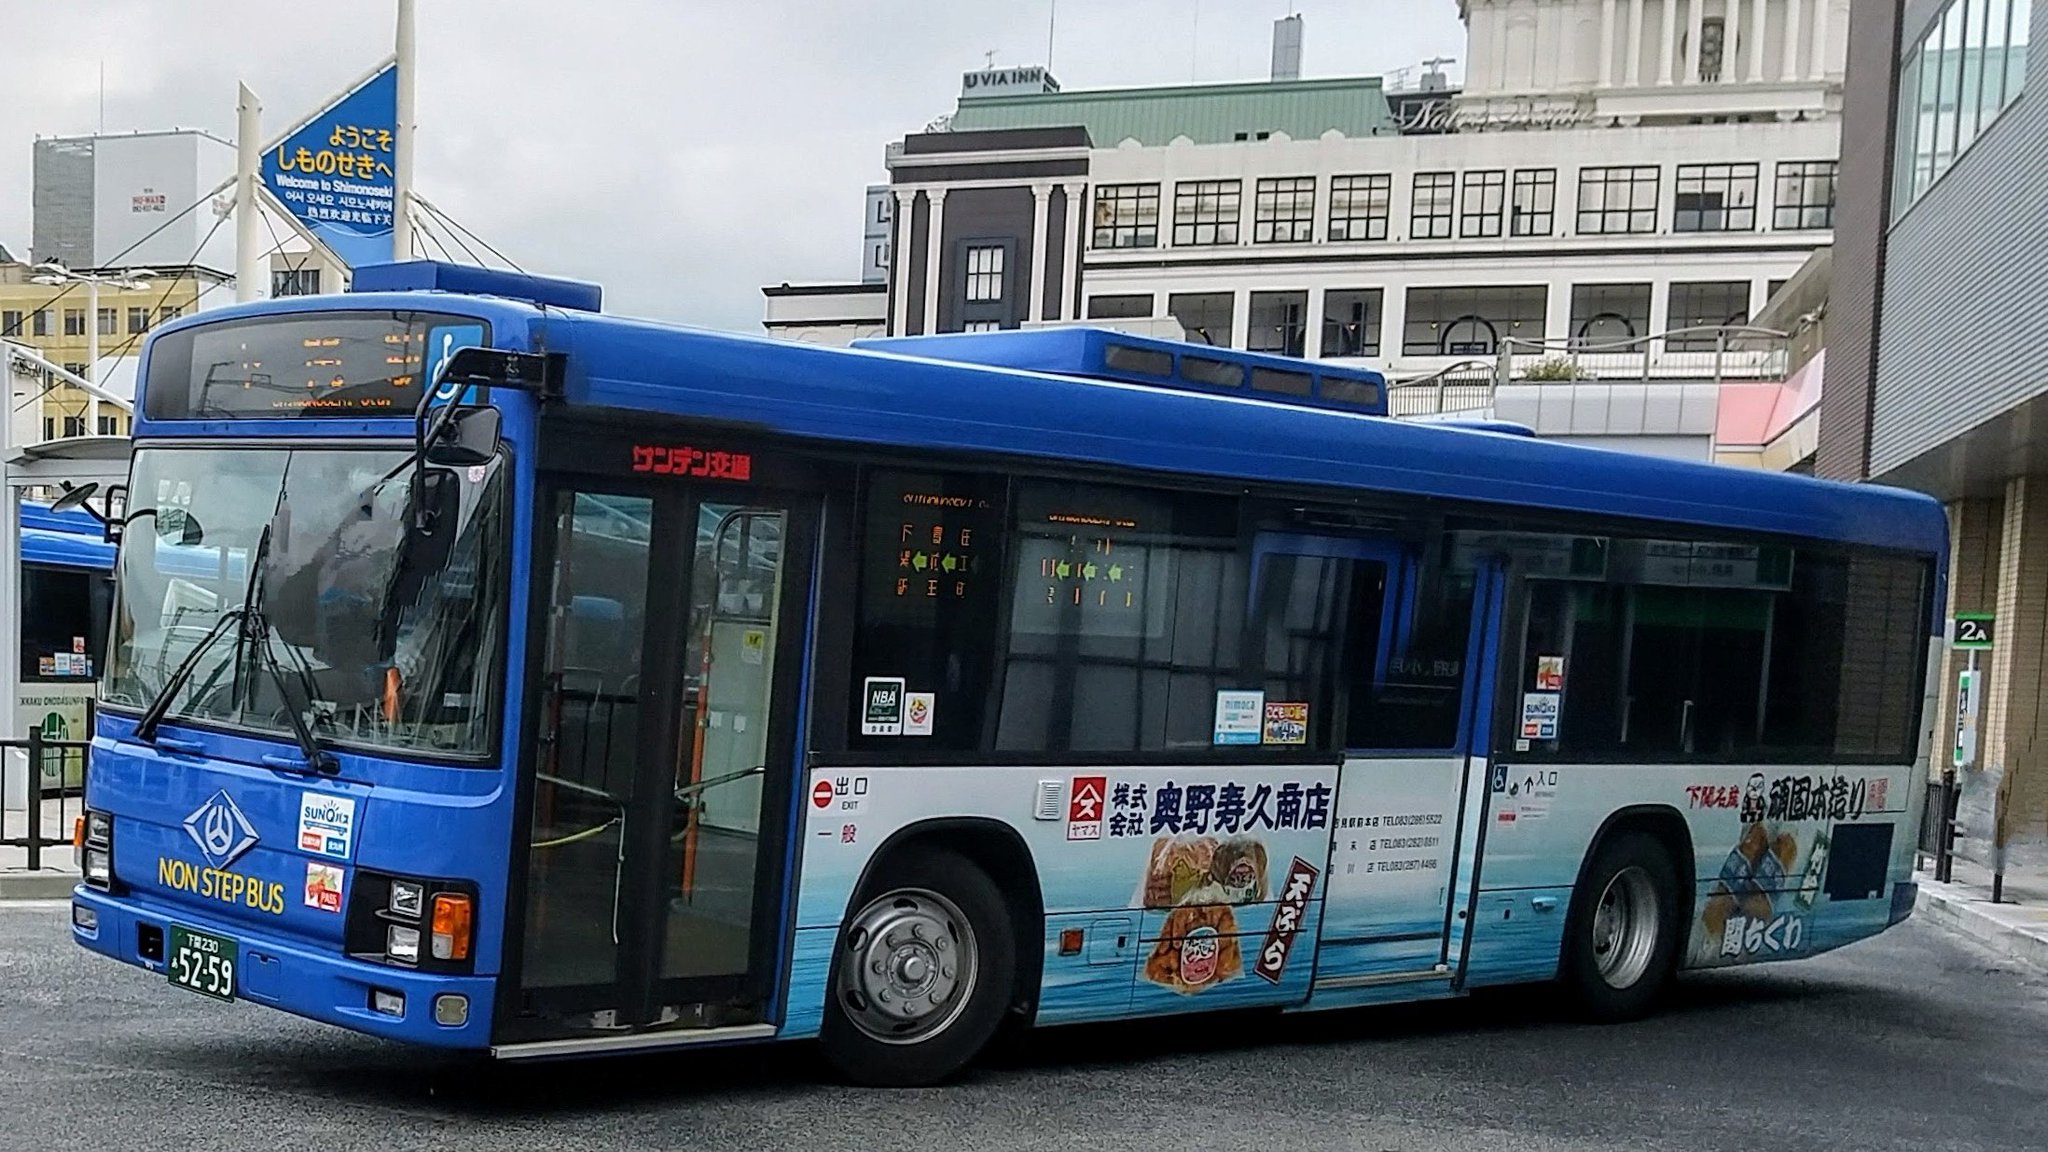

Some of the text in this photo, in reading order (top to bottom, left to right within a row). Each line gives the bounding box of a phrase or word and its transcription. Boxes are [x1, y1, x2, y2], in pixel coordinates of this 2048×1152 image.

[981, 73, 1008, 87] VIA
[1012, 70, 1041, 84] INN
[329, 124, 393, 152] ようこそ
[278, 145, 394, 179] しものせきへ
[275, 174, 393, 198] Welcome to Shimonoseki
[872, 690, 896, 706] NBA
[835, 776, 868, 796] 出口
[1536, 771, 1558, 786] 入口
[841, 801, 859, 810] EXIT
[1112, 783, 1148, 809] 株式
[1150, 781, 1332, 834] 奥野寿久商店
[817, 824, 857, 844] 一般
[1071, 823, 1099, 837] ヤマス
[1109, 812, 1145, 837] 会社
[159, 857, 284, 915] NON STEP BUS
[321, 892, 338, 905] PASS
[1264, 873, 1311, 971] 天ぷら
[202, 938, 219, 953] 230
